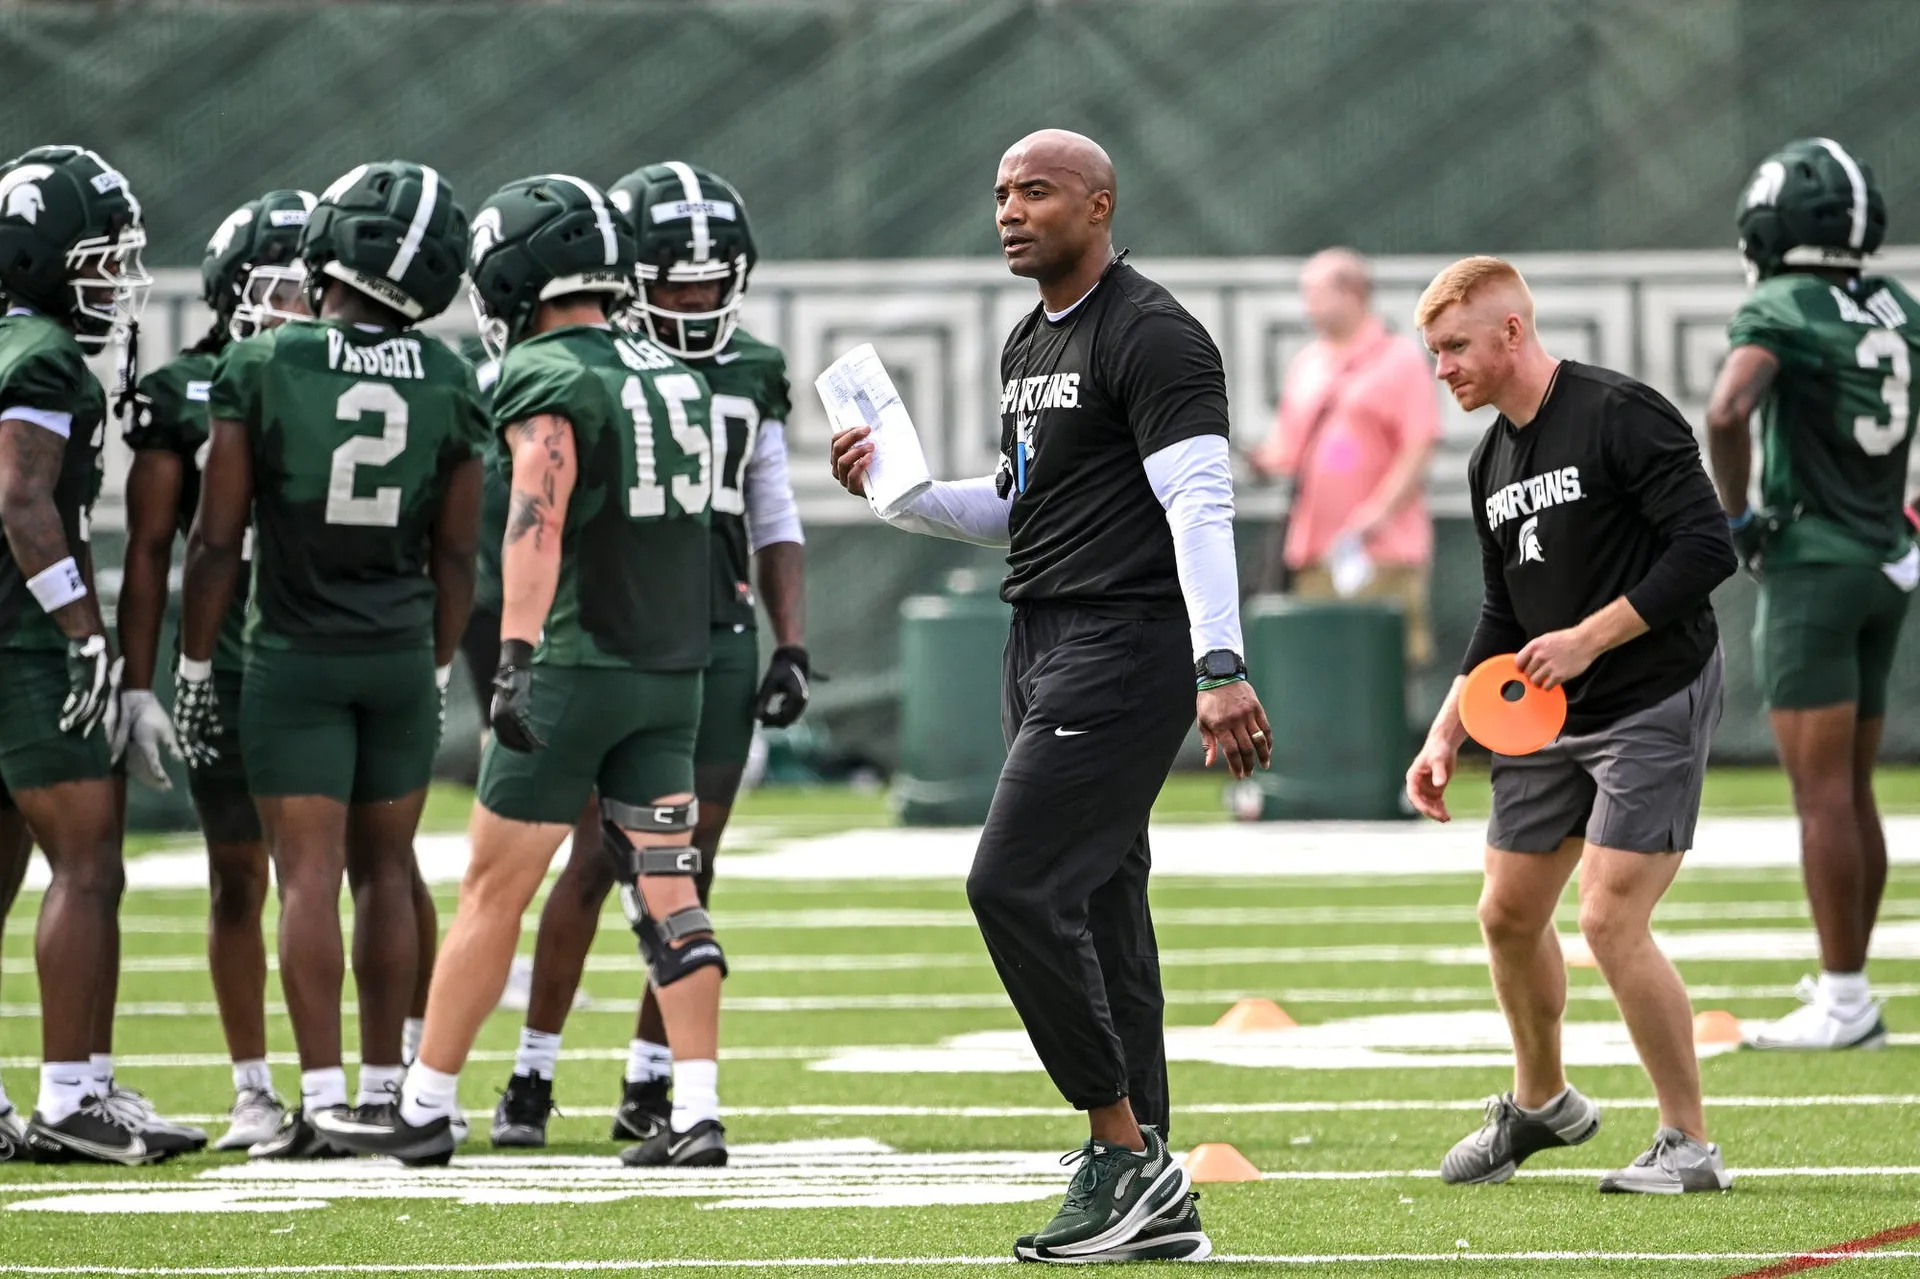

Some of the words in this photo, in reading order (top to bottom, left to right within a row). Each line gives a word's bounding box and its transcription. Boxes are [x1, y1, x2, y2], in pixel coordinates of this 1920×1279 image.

[327, 328, 425, 379] VAUGHT
[1854, 328, 1911, 456] 3
[325, 381, 409, 527] 2
[621, 374, 711, 517] 15
[1485, 466, 1581, 532] SPARTANS
